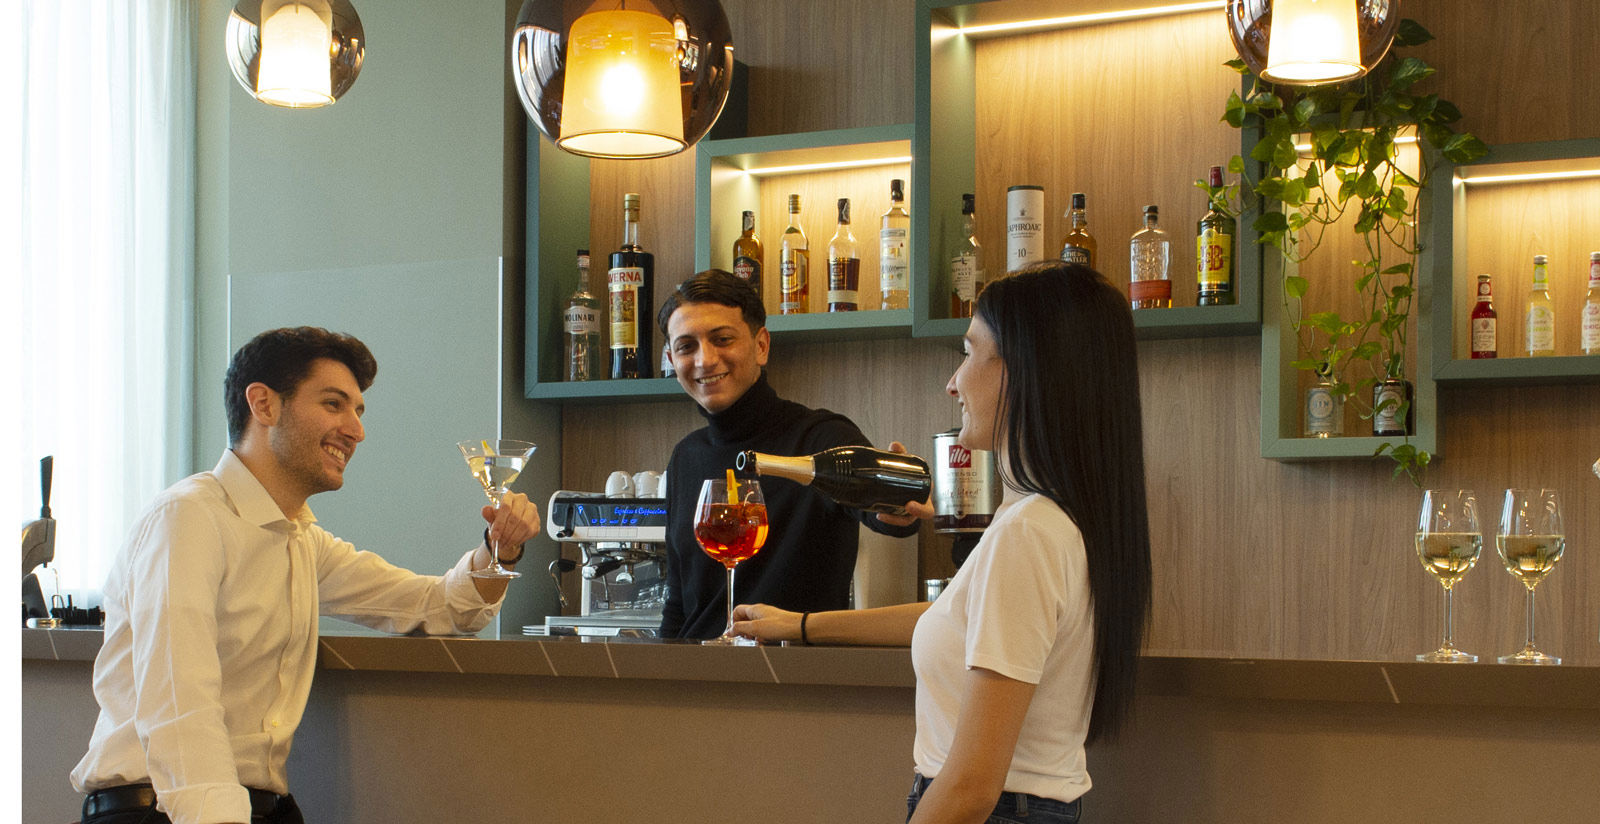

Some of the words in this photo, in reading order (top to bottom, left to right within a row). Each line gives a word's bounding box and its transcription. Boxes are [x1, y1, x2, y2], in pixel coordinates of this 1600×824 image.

[1008, 223, 1042, 232] APHROAIG
[1017, 247, 1027, 258] 10
[1198, 244, 1224, 272] J&B
[565, 313, 595, 322] MOLINARI
[950, 448, 970, 466] illy
